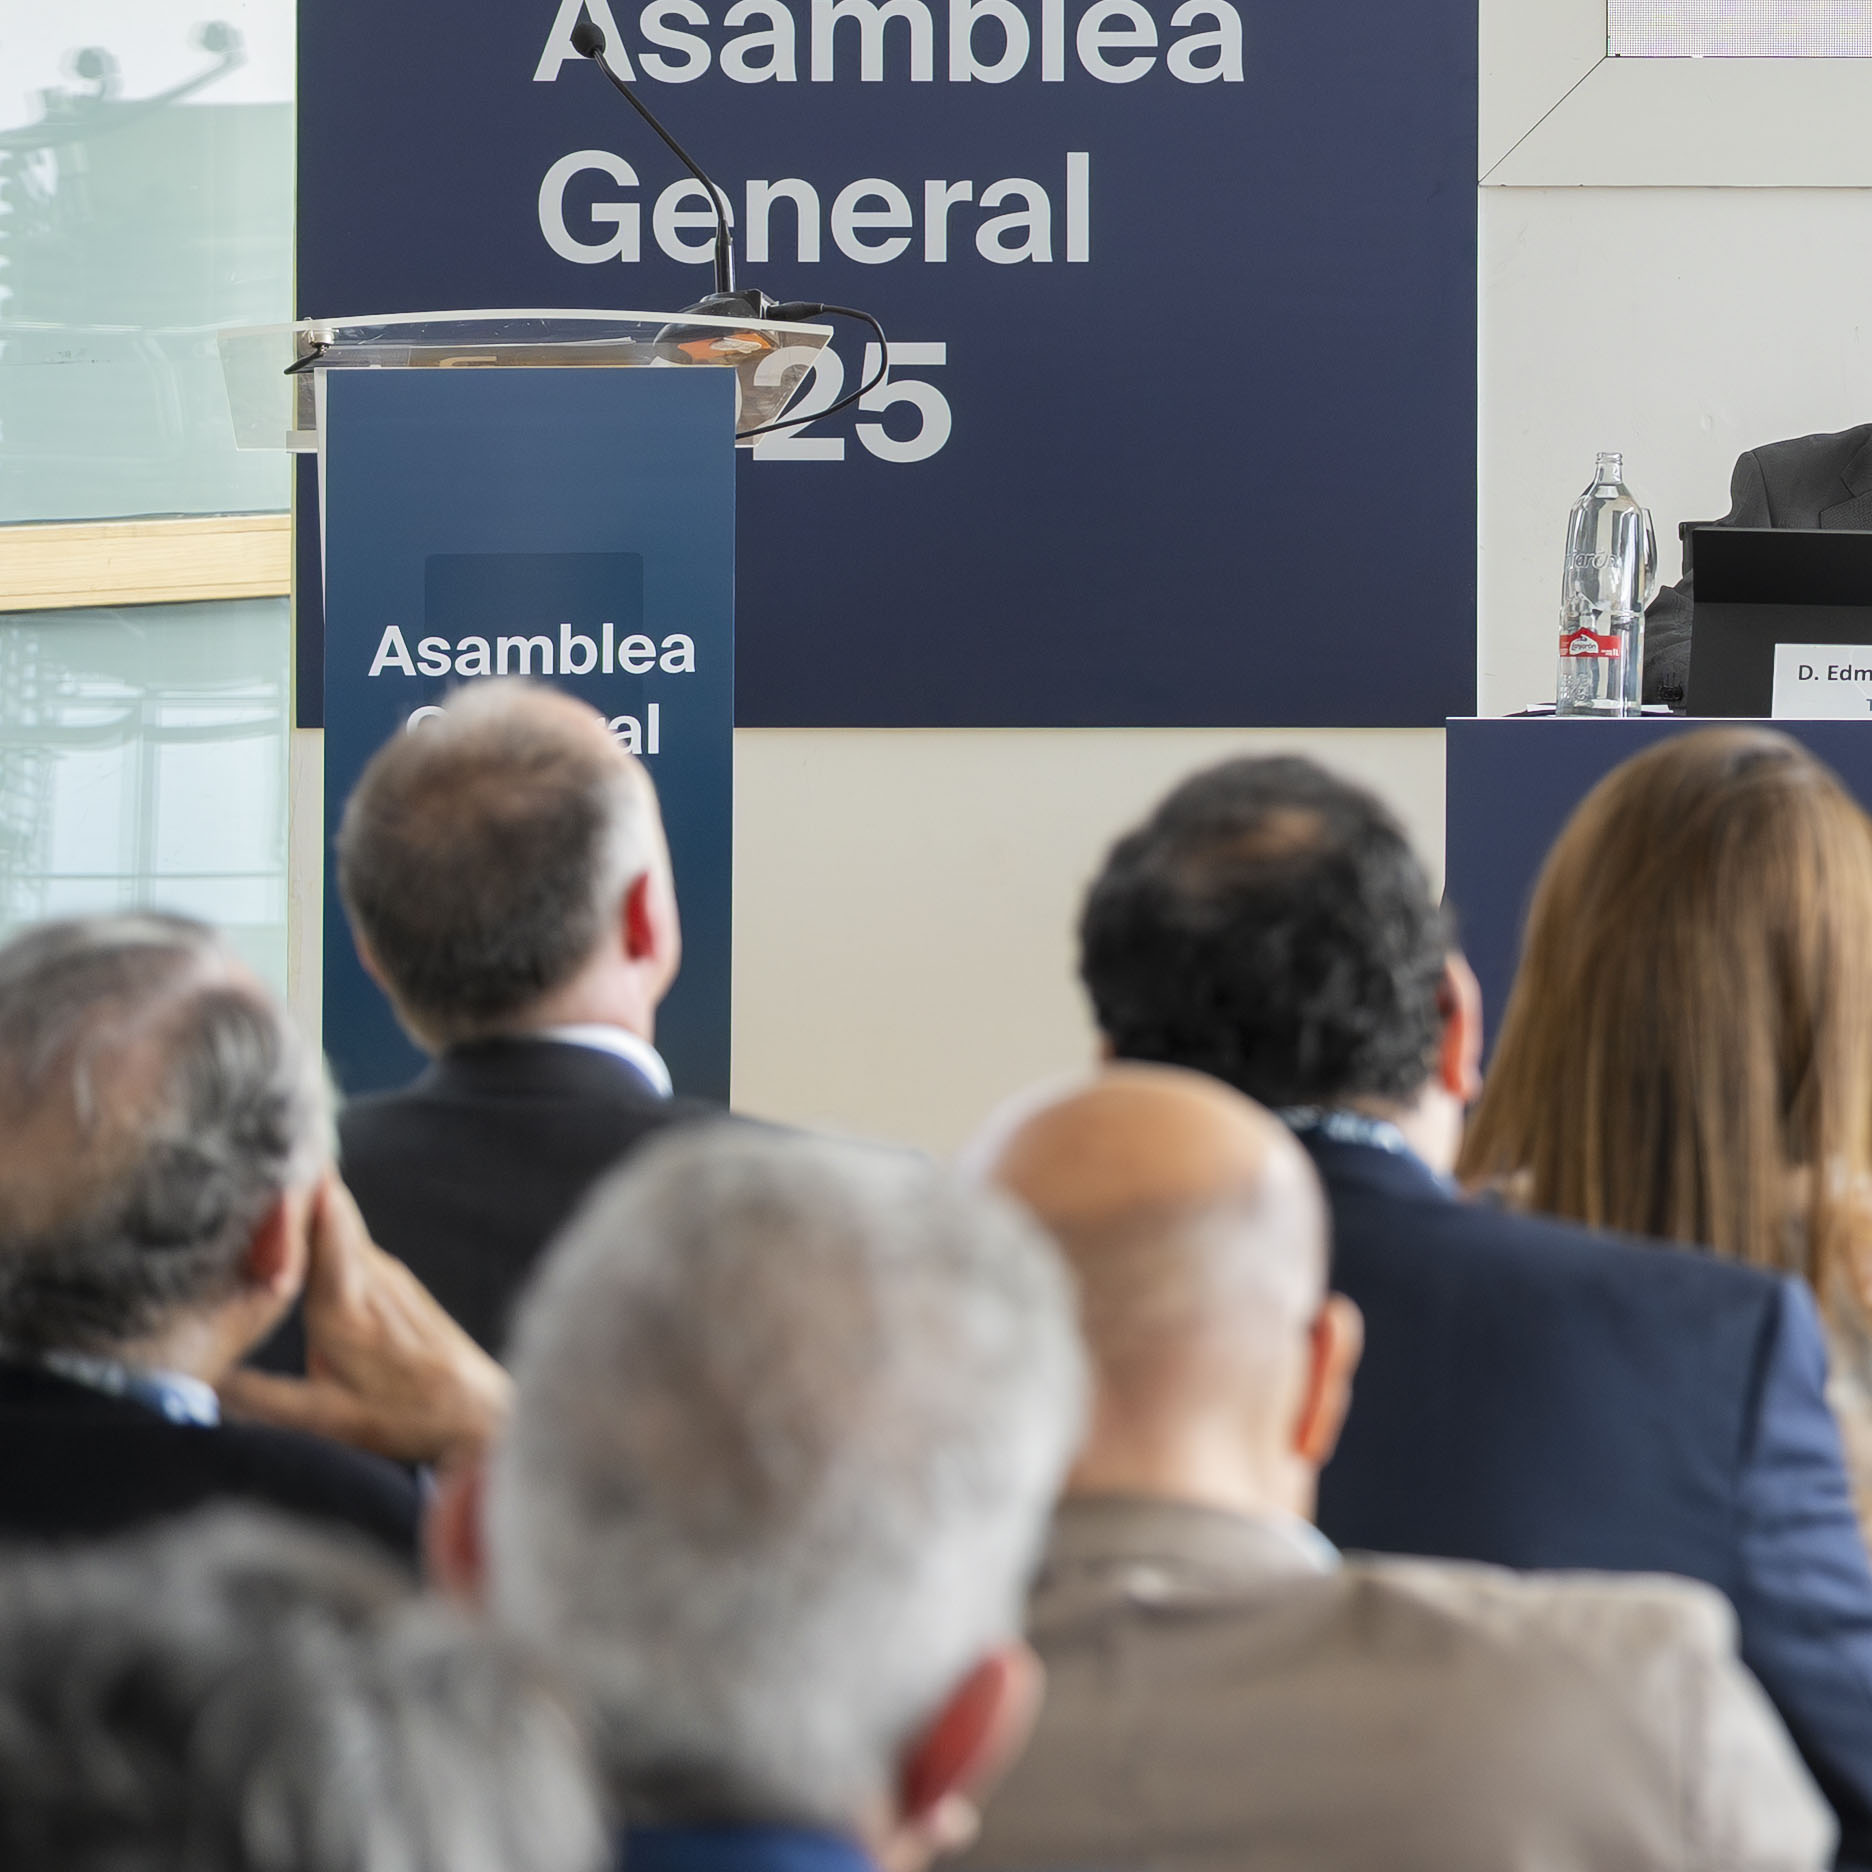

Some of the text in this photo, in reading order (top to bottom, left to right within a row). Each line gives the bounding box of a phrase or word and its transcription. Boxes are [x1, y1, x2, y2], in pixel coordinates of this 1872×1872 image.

[539, 150, 1089, 264] General
[740, 342, 953, 463] 25
[368, 623, 696, 677] Asamblea
[1799, 665, 1818, 680] D.
